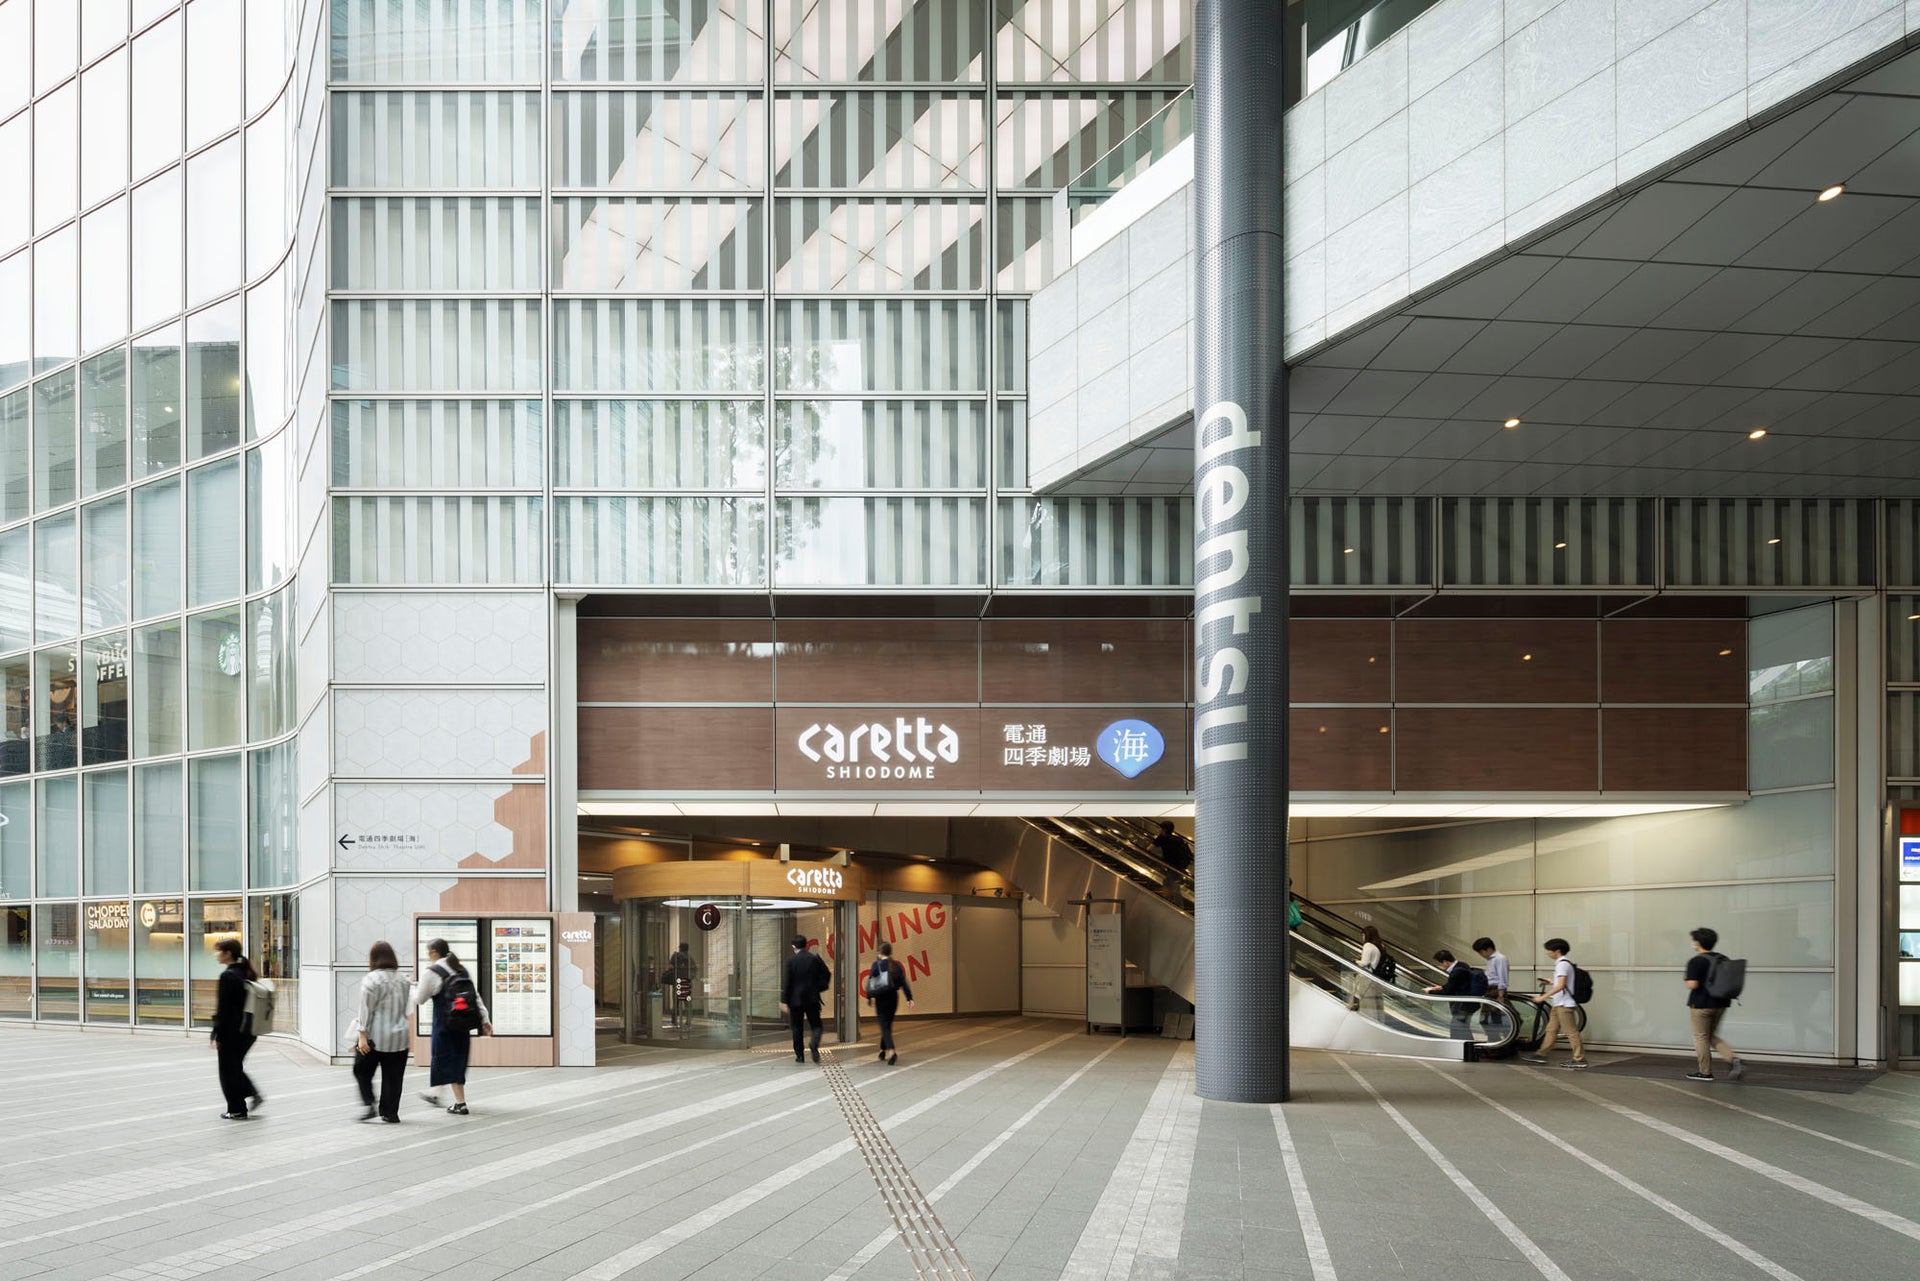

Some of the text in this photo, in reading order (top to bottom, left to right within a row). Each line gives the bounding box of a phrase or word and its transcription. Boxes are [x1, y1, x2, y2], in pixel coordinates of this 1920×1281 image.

[1194, 400, 1261, 772] dentsu
[798, 717, 959, 763] caretta
[1003, 724, 1047, 744] 電通
[1113, 729, 1149, 763] 海
[1003, 746, 1092, 767] 四季劇場
[827, 766, 935, 779] SHIODOME
[786, 868, 843, 889] caretta
[798, 887, 836, 895] SHIODOME
[88, 920, 114, 929] SALAD
[702, 911, 712, 926] C
[561, 930, 592, 940] caretta
